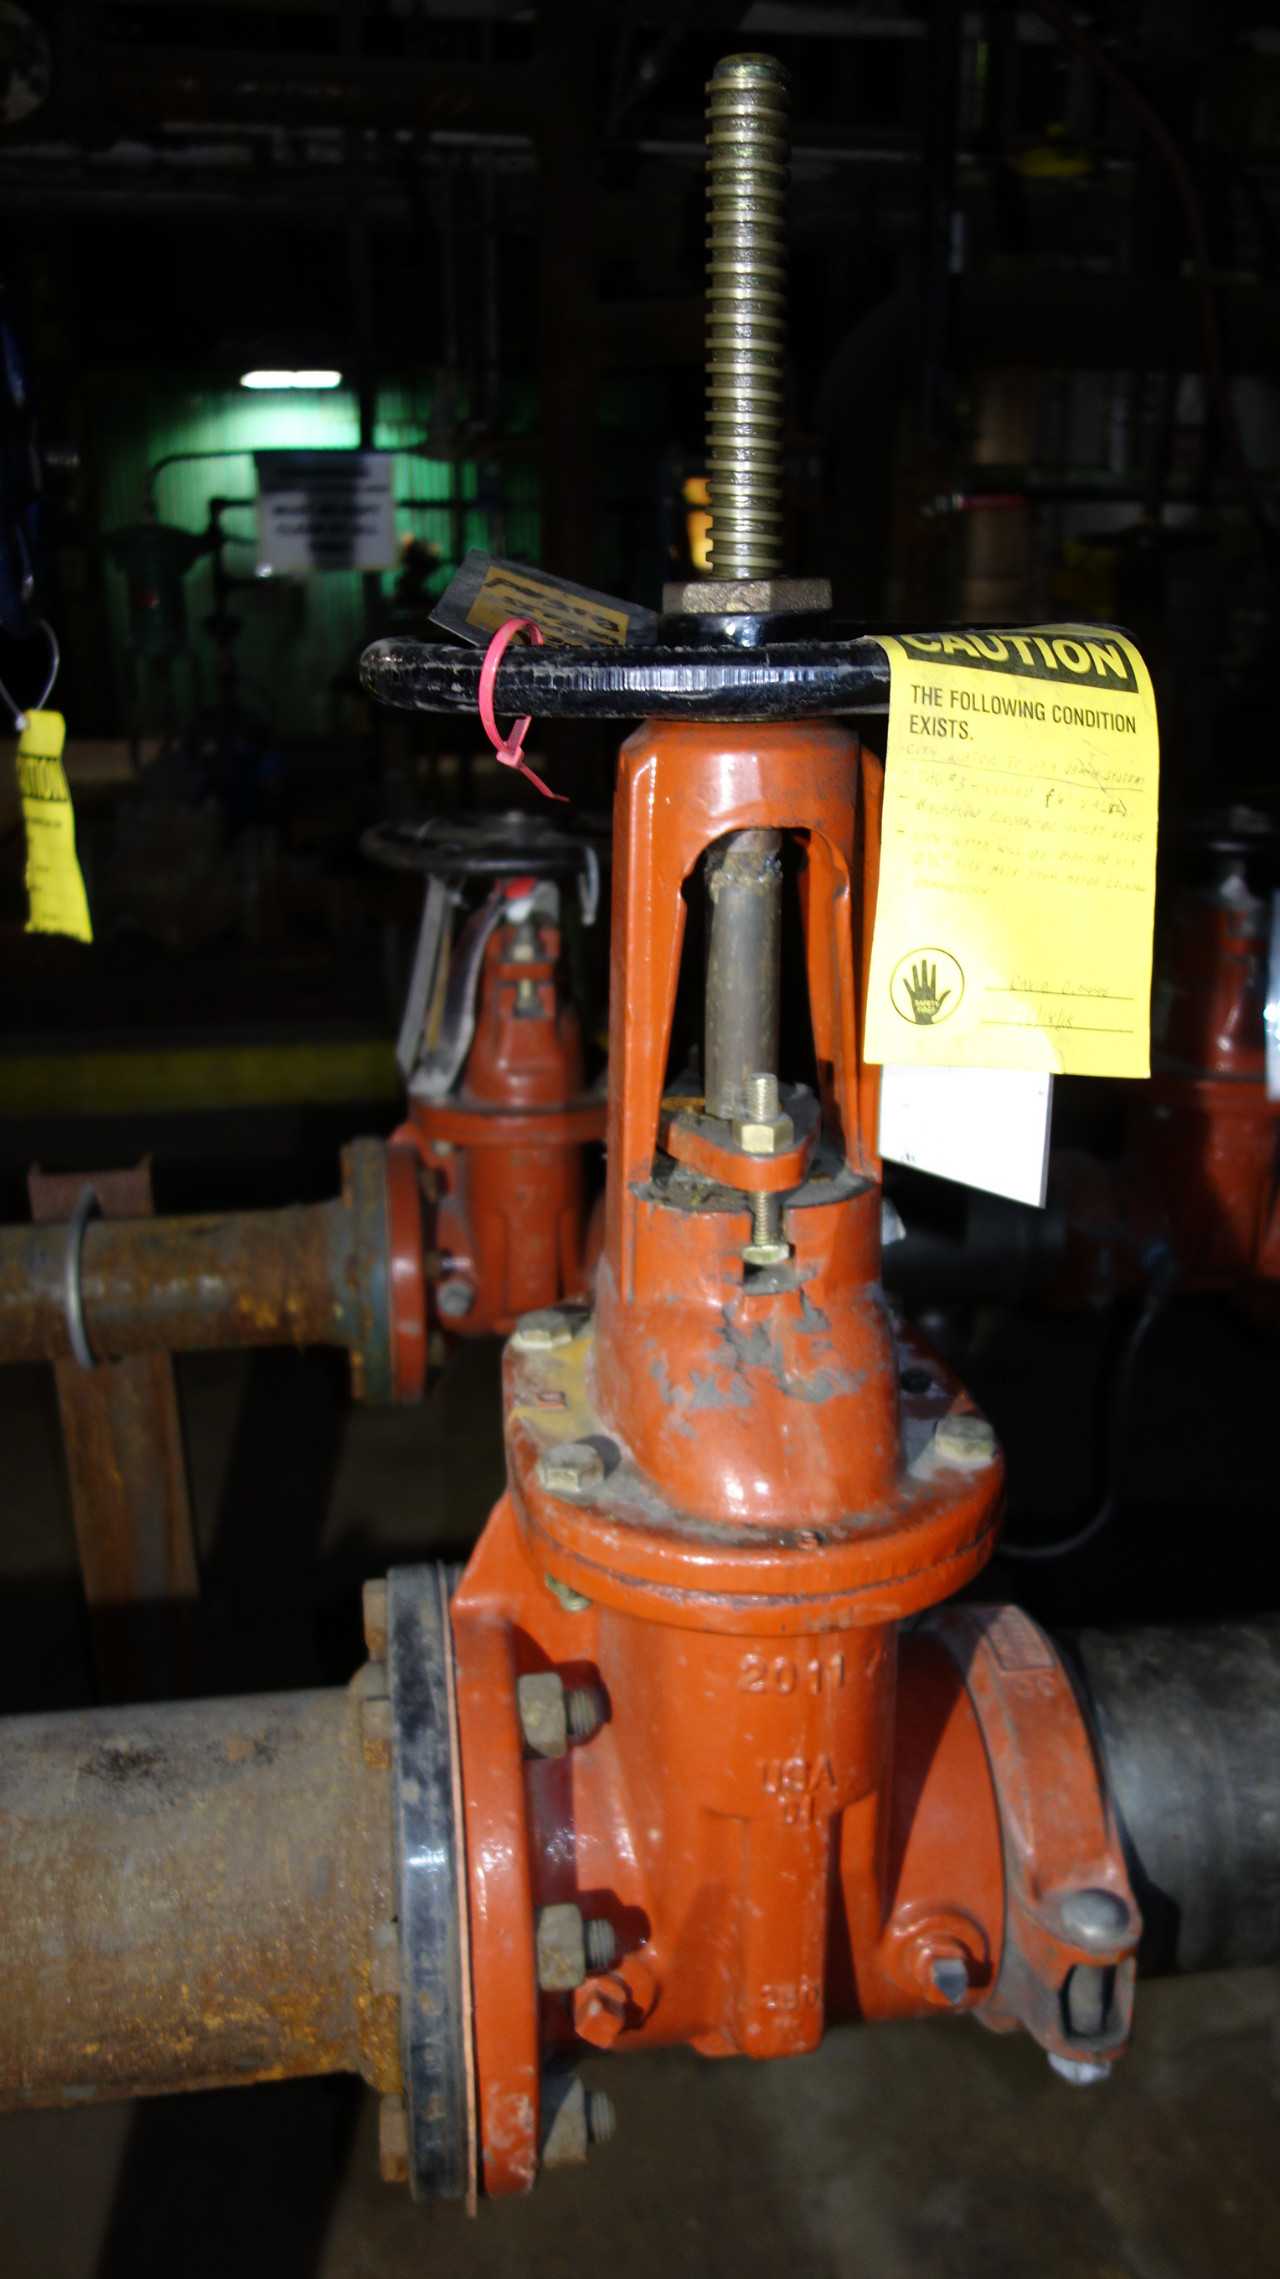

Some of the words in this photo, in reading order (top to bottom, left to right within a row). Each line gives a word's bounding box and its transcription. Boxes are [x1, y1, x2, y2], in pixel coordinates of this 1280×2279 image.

[901, 633, 1129, 680] CAUTION
[909, 714, 975, 742] EXISTS.
[910, 684, 944, 708] THE
[949, 689, 1047, 721] FOLLOWING
[1051, 704, 1137, 735] CONDITION
[737, 1652, 846, 1696] 2011
